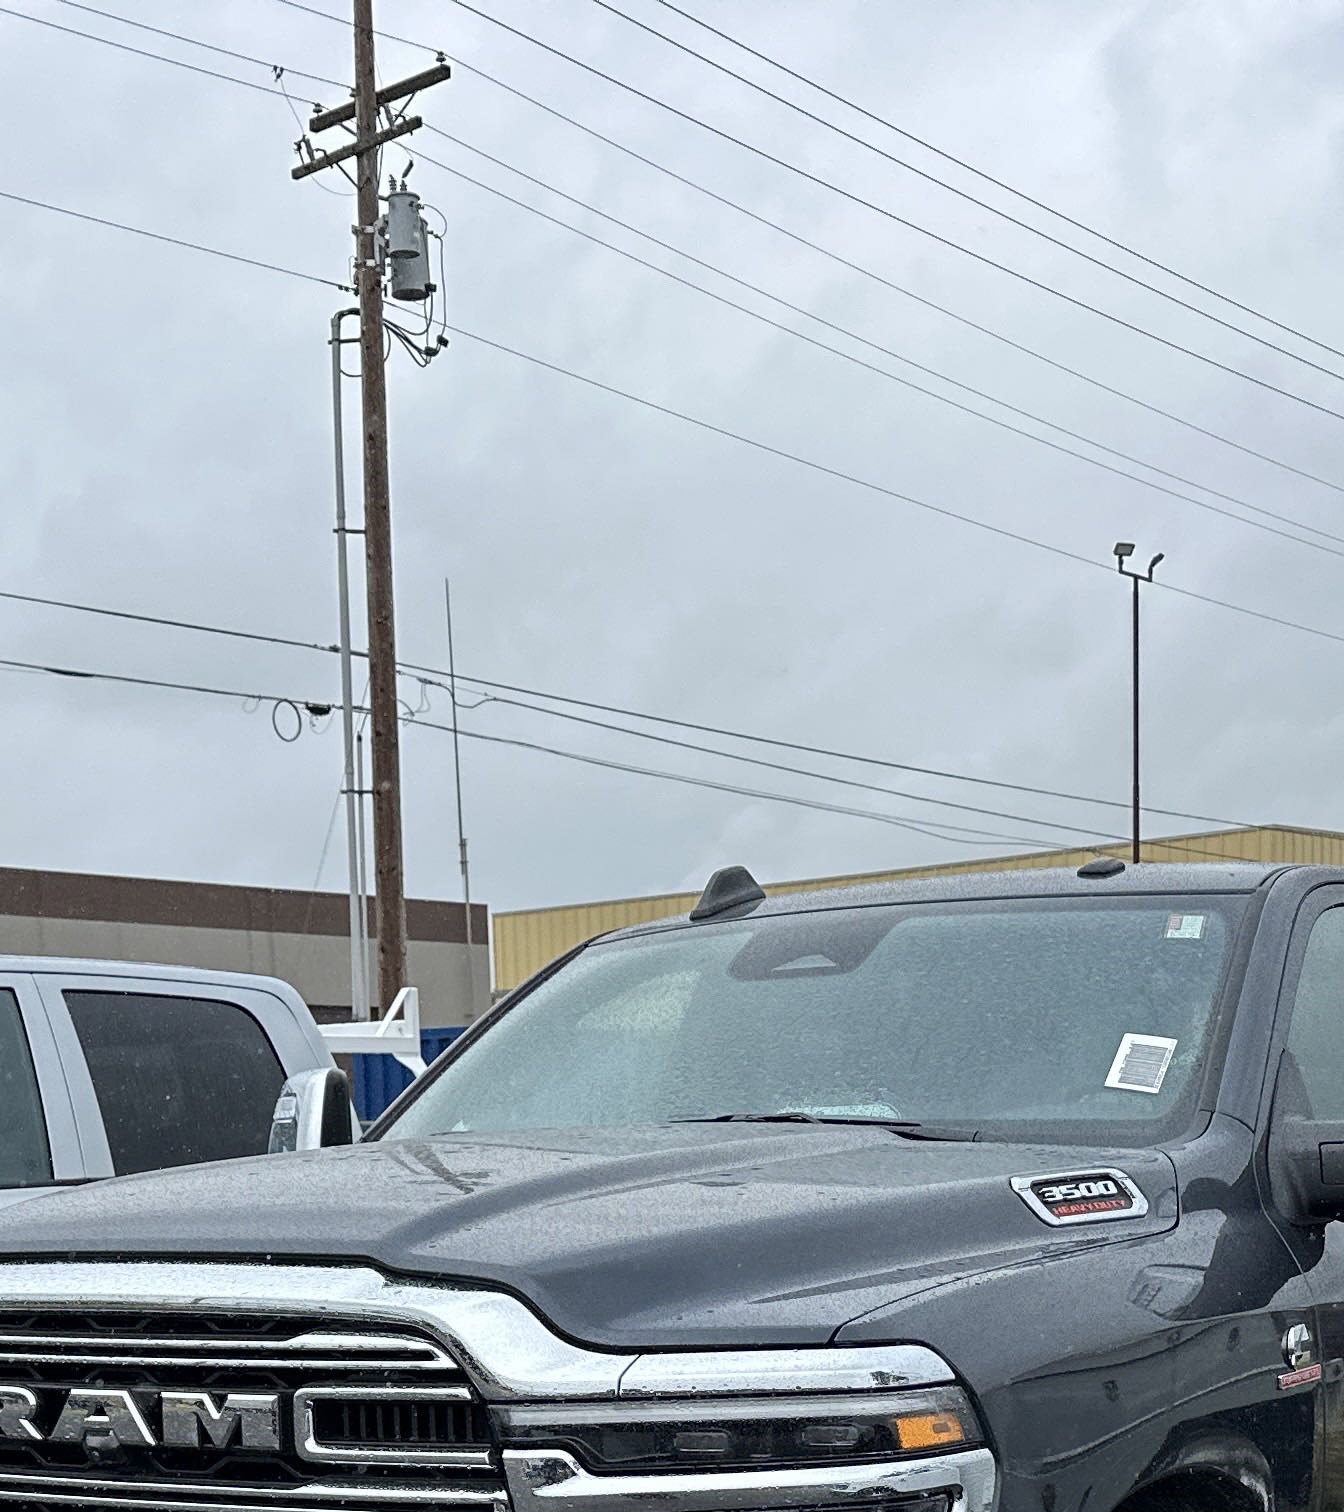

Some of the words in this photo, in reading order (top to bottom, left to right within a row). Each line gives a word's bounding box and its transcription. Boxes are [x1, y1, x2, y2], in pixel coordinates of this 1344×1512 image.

[1038, 1180, 1118, 1202] 3500
[1052, 1203, 1093, 1215] HEAVY
[1093, 1200, 1126, 1210] DUTY
